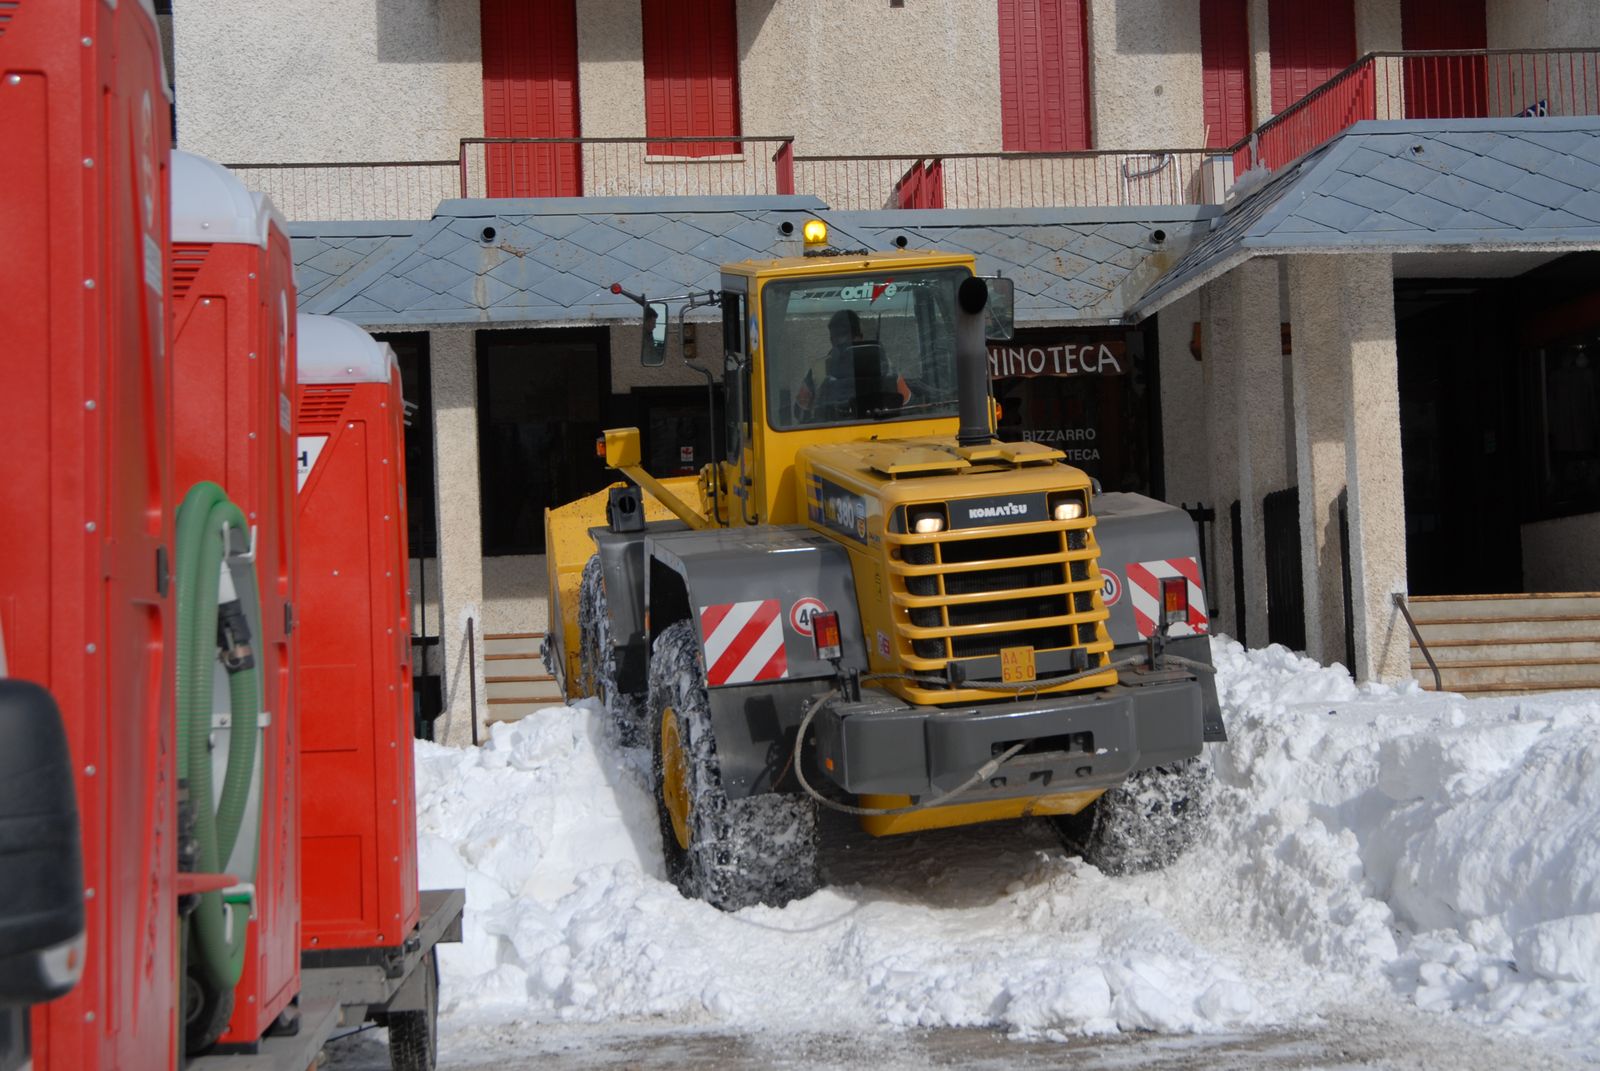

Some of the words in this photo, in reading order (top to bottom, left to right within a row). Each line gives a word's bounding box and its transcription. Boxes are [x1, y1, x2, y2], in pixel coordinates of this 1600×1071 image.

[841, 278, 897, 304] active
[1022, 428, 1096, 441] BIZZARRO
[1060, 448, 1100, 462] TECA
[969, 502, 1028, 519] KOMATSU
[1003, 665, 1035, 680] 650
